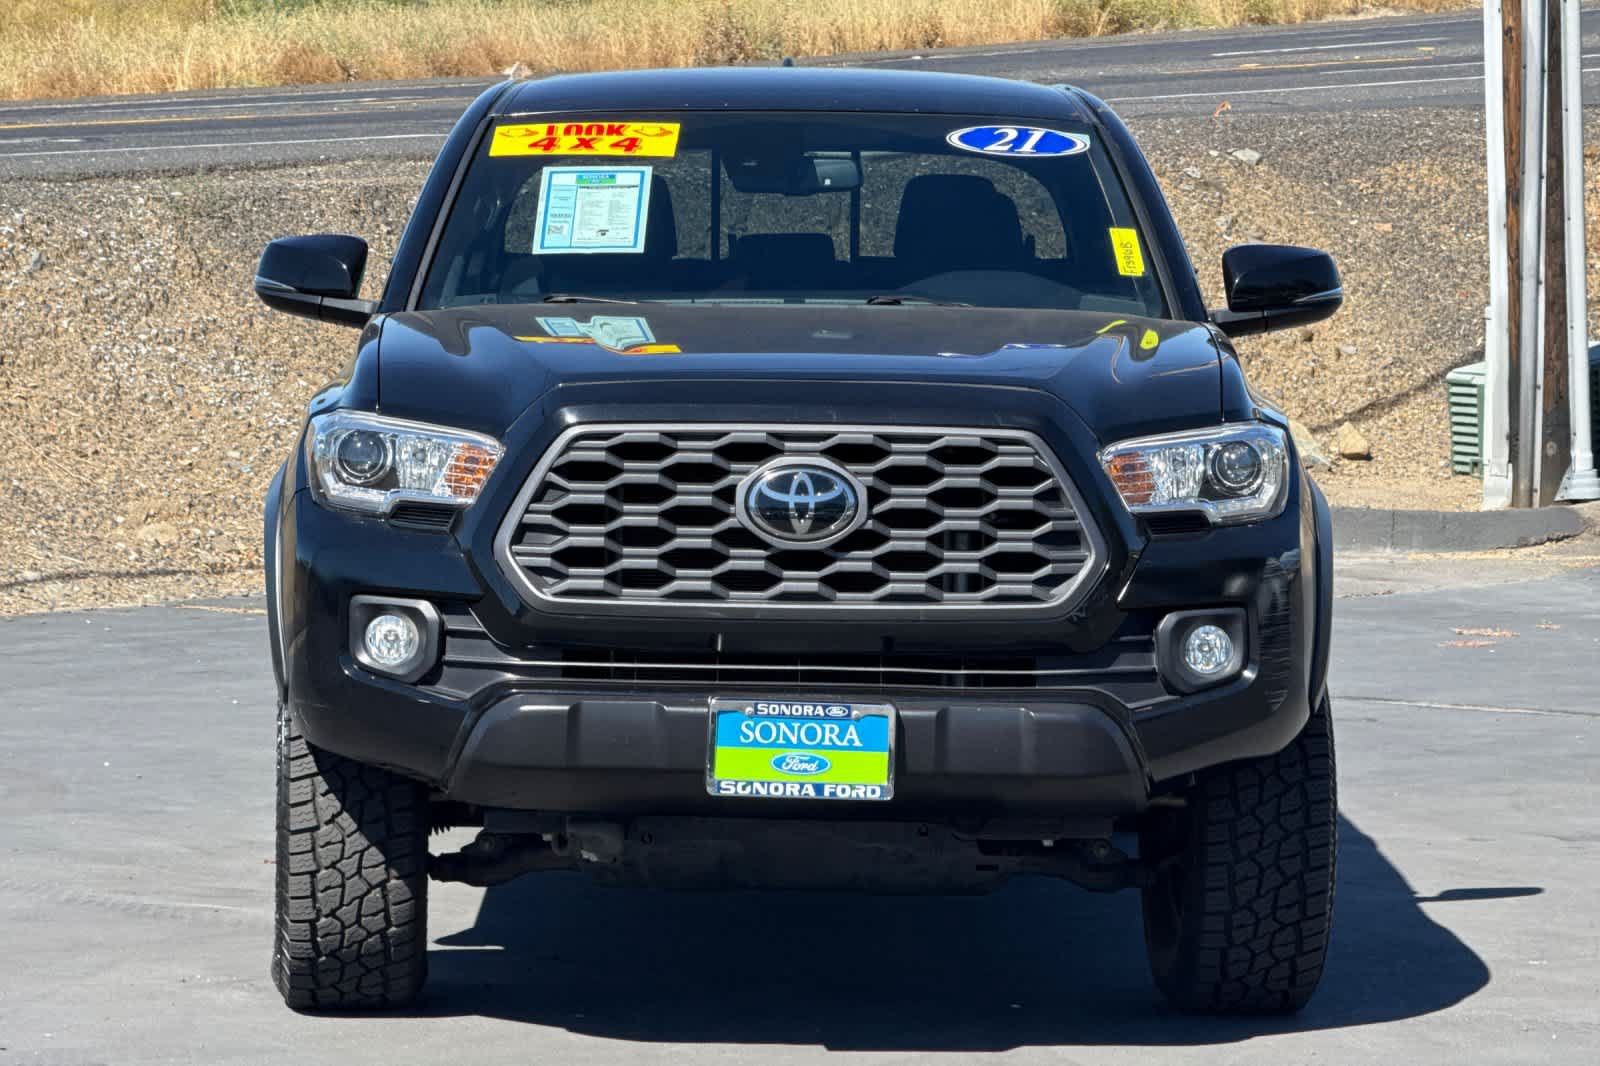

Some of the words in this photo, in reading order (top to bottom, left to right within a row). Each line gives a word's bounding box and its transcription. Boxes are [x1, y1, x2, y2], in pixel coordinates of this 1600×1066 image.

[984, 129, 1042, 153] 21
[757, 703, 825, 717] SONORA
[739, 720, 863, 747] SONORA
[719, 781, 817, 796] SONORA
[823, 784, 881, 798] FORD
